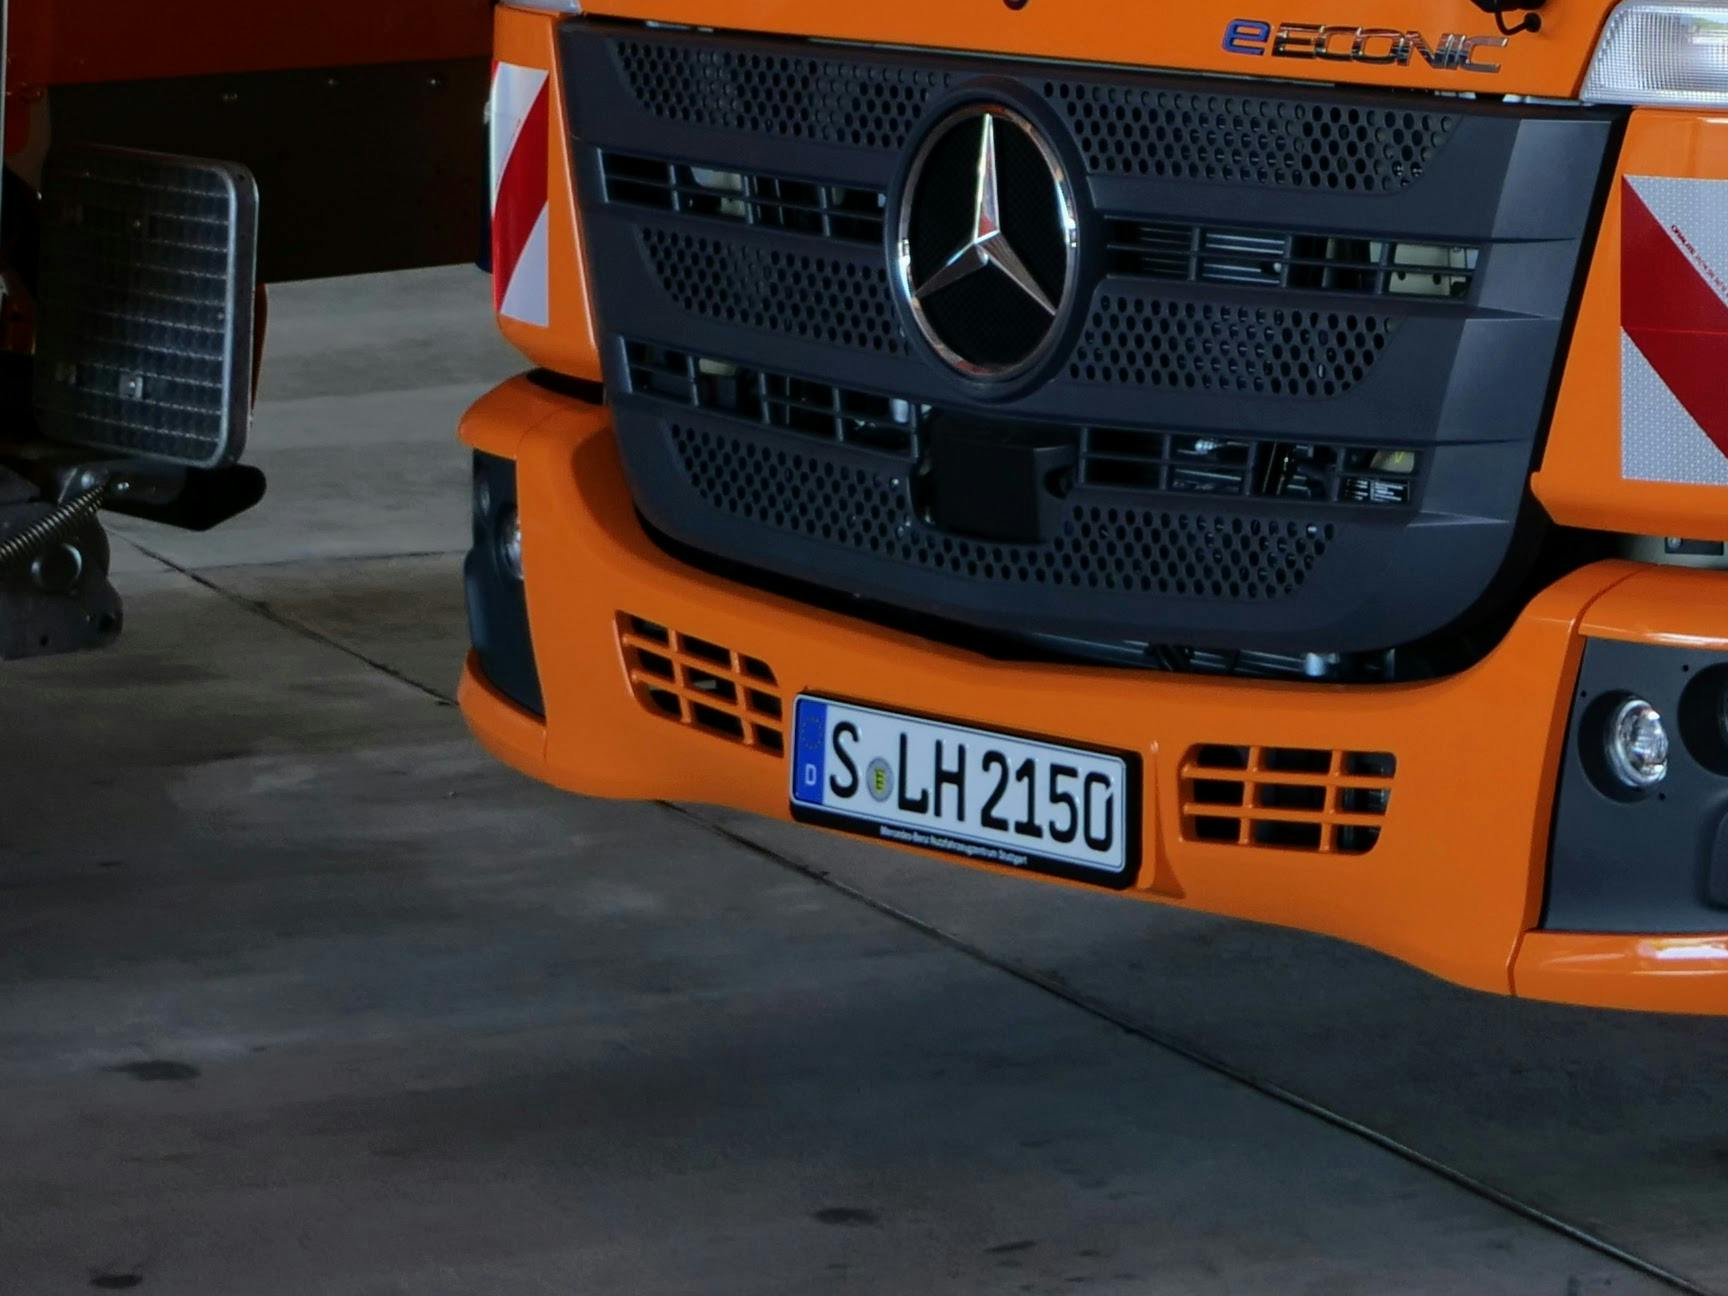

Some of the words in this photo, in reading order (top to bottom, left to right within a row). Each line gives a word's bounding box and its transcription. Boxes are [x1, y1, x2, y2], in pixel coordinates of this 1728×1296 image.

[805, 763, 816, 786] D
[829, 720, 860, 799] S
[897, 732, 966, 823] LH
[981, 751, 1114, 853] 2150
